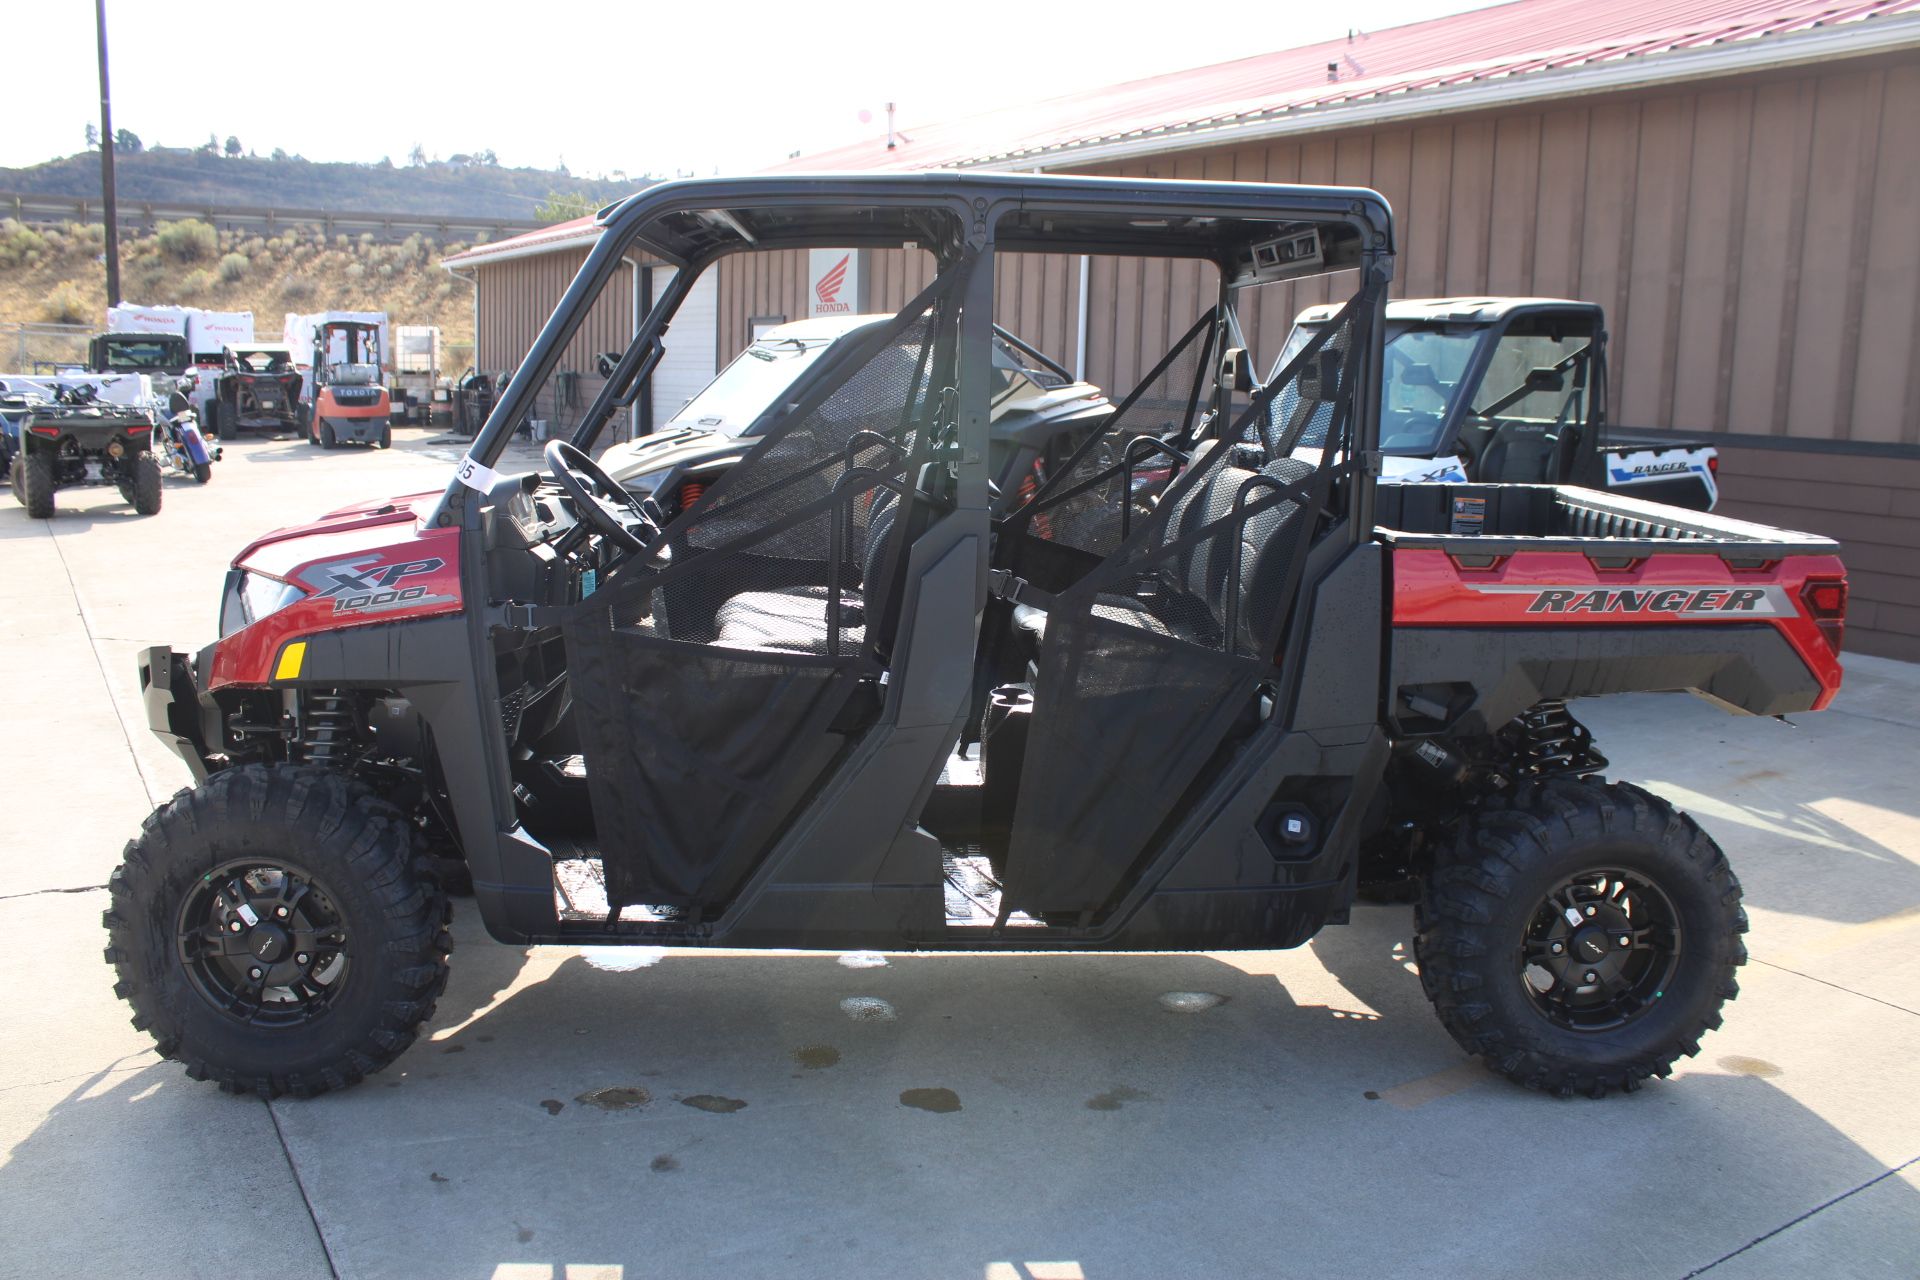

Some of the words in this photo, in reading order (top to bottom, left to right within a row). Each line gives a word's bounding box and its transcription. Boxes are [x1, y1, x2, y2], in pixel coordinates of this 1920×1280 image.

[816, 303, 850, 313] HONDA
[1420, 465, 1459, 482] XP
[1633, 462, 1688, 474] RANGER
[307, 557, 445, 600] XP
[333, 586, 428, 612] 1000
[1526, 589, 1767, 612] RANGER
